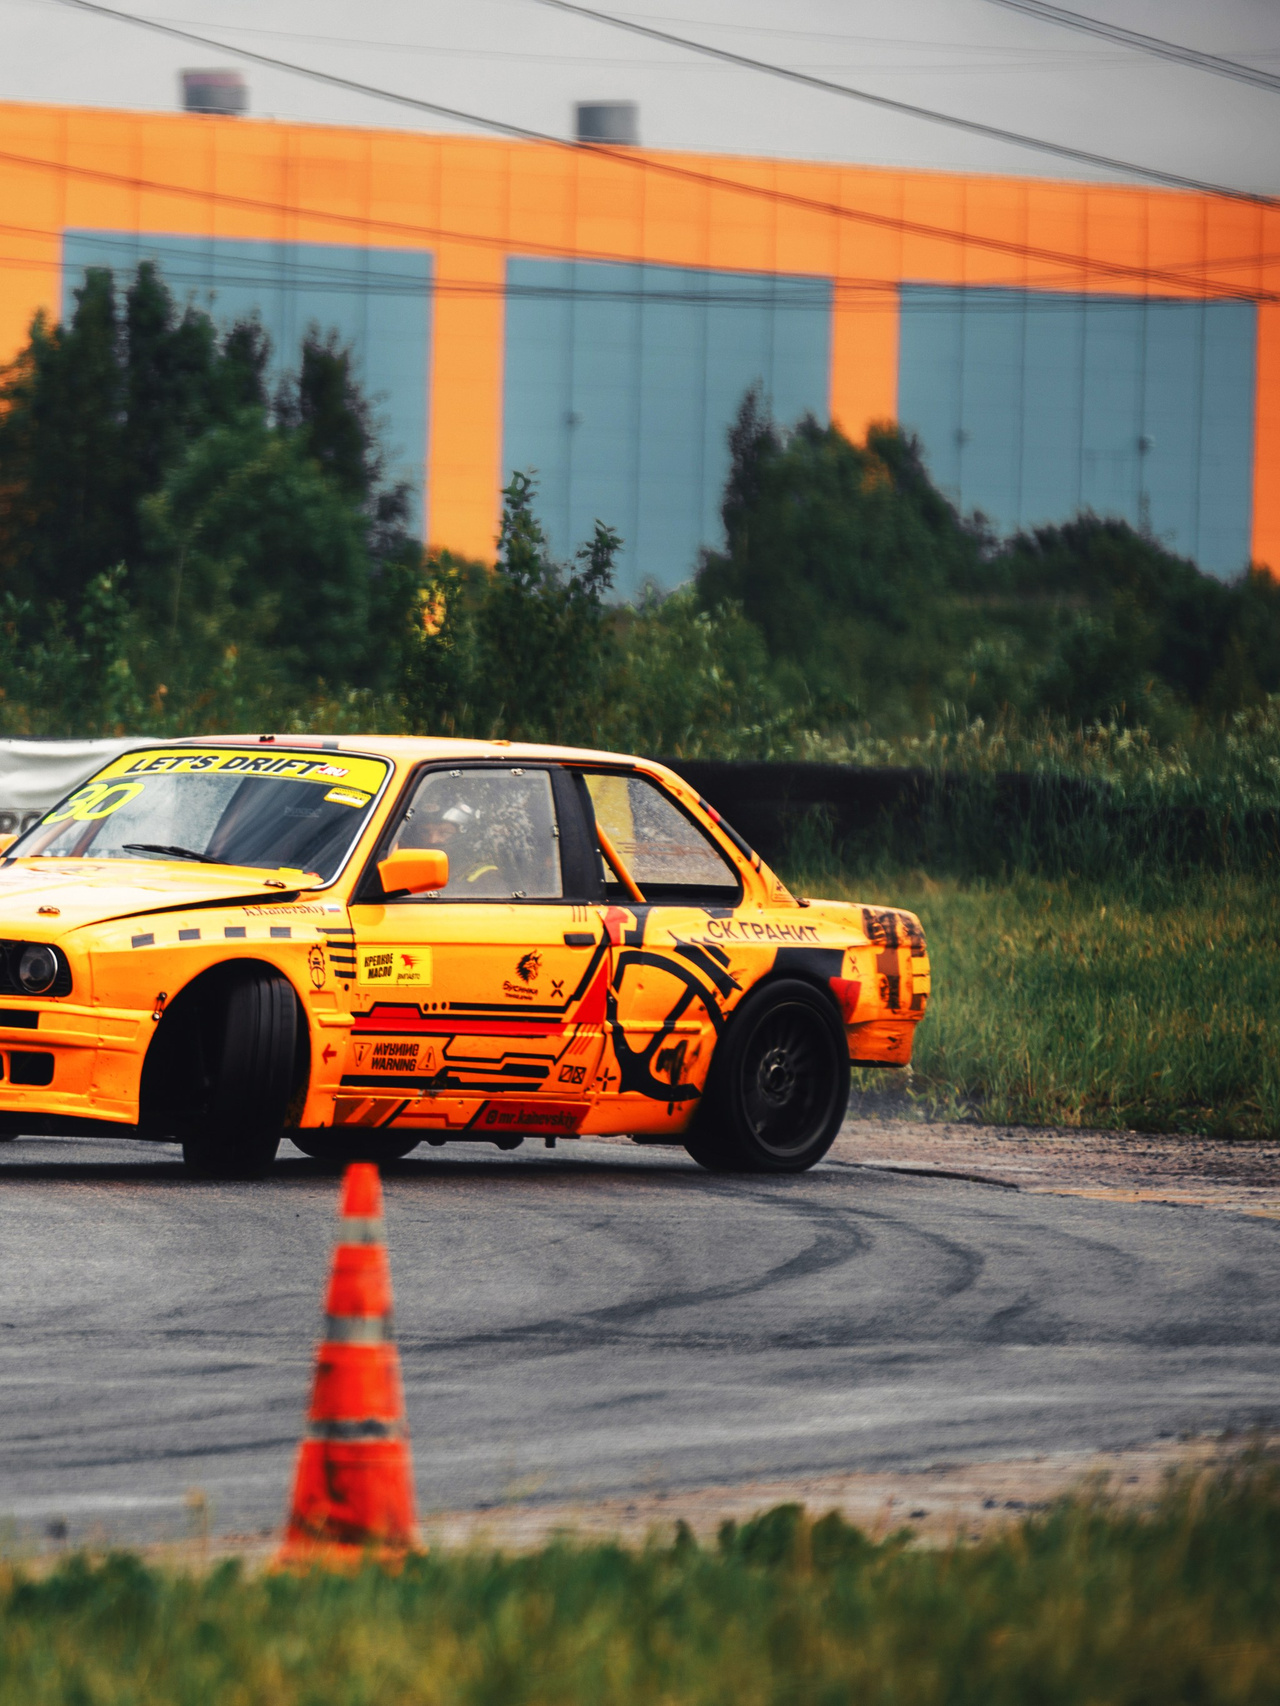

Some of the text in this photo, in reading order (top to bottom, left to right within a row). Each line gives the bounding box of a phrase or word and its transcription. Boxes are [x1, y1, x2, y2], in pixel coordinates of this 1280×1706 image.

[124, 756, 220, 775] LET'S
[41, 783, 146, 826] 30
[707, 920, 820, 942] СК ГРАНИТ
[364, 953, 393, 967] КРЕПКОЕ
[368, 965, 393, 979] МАСЛО
[371, 1057, 418, 1071] WARNING
